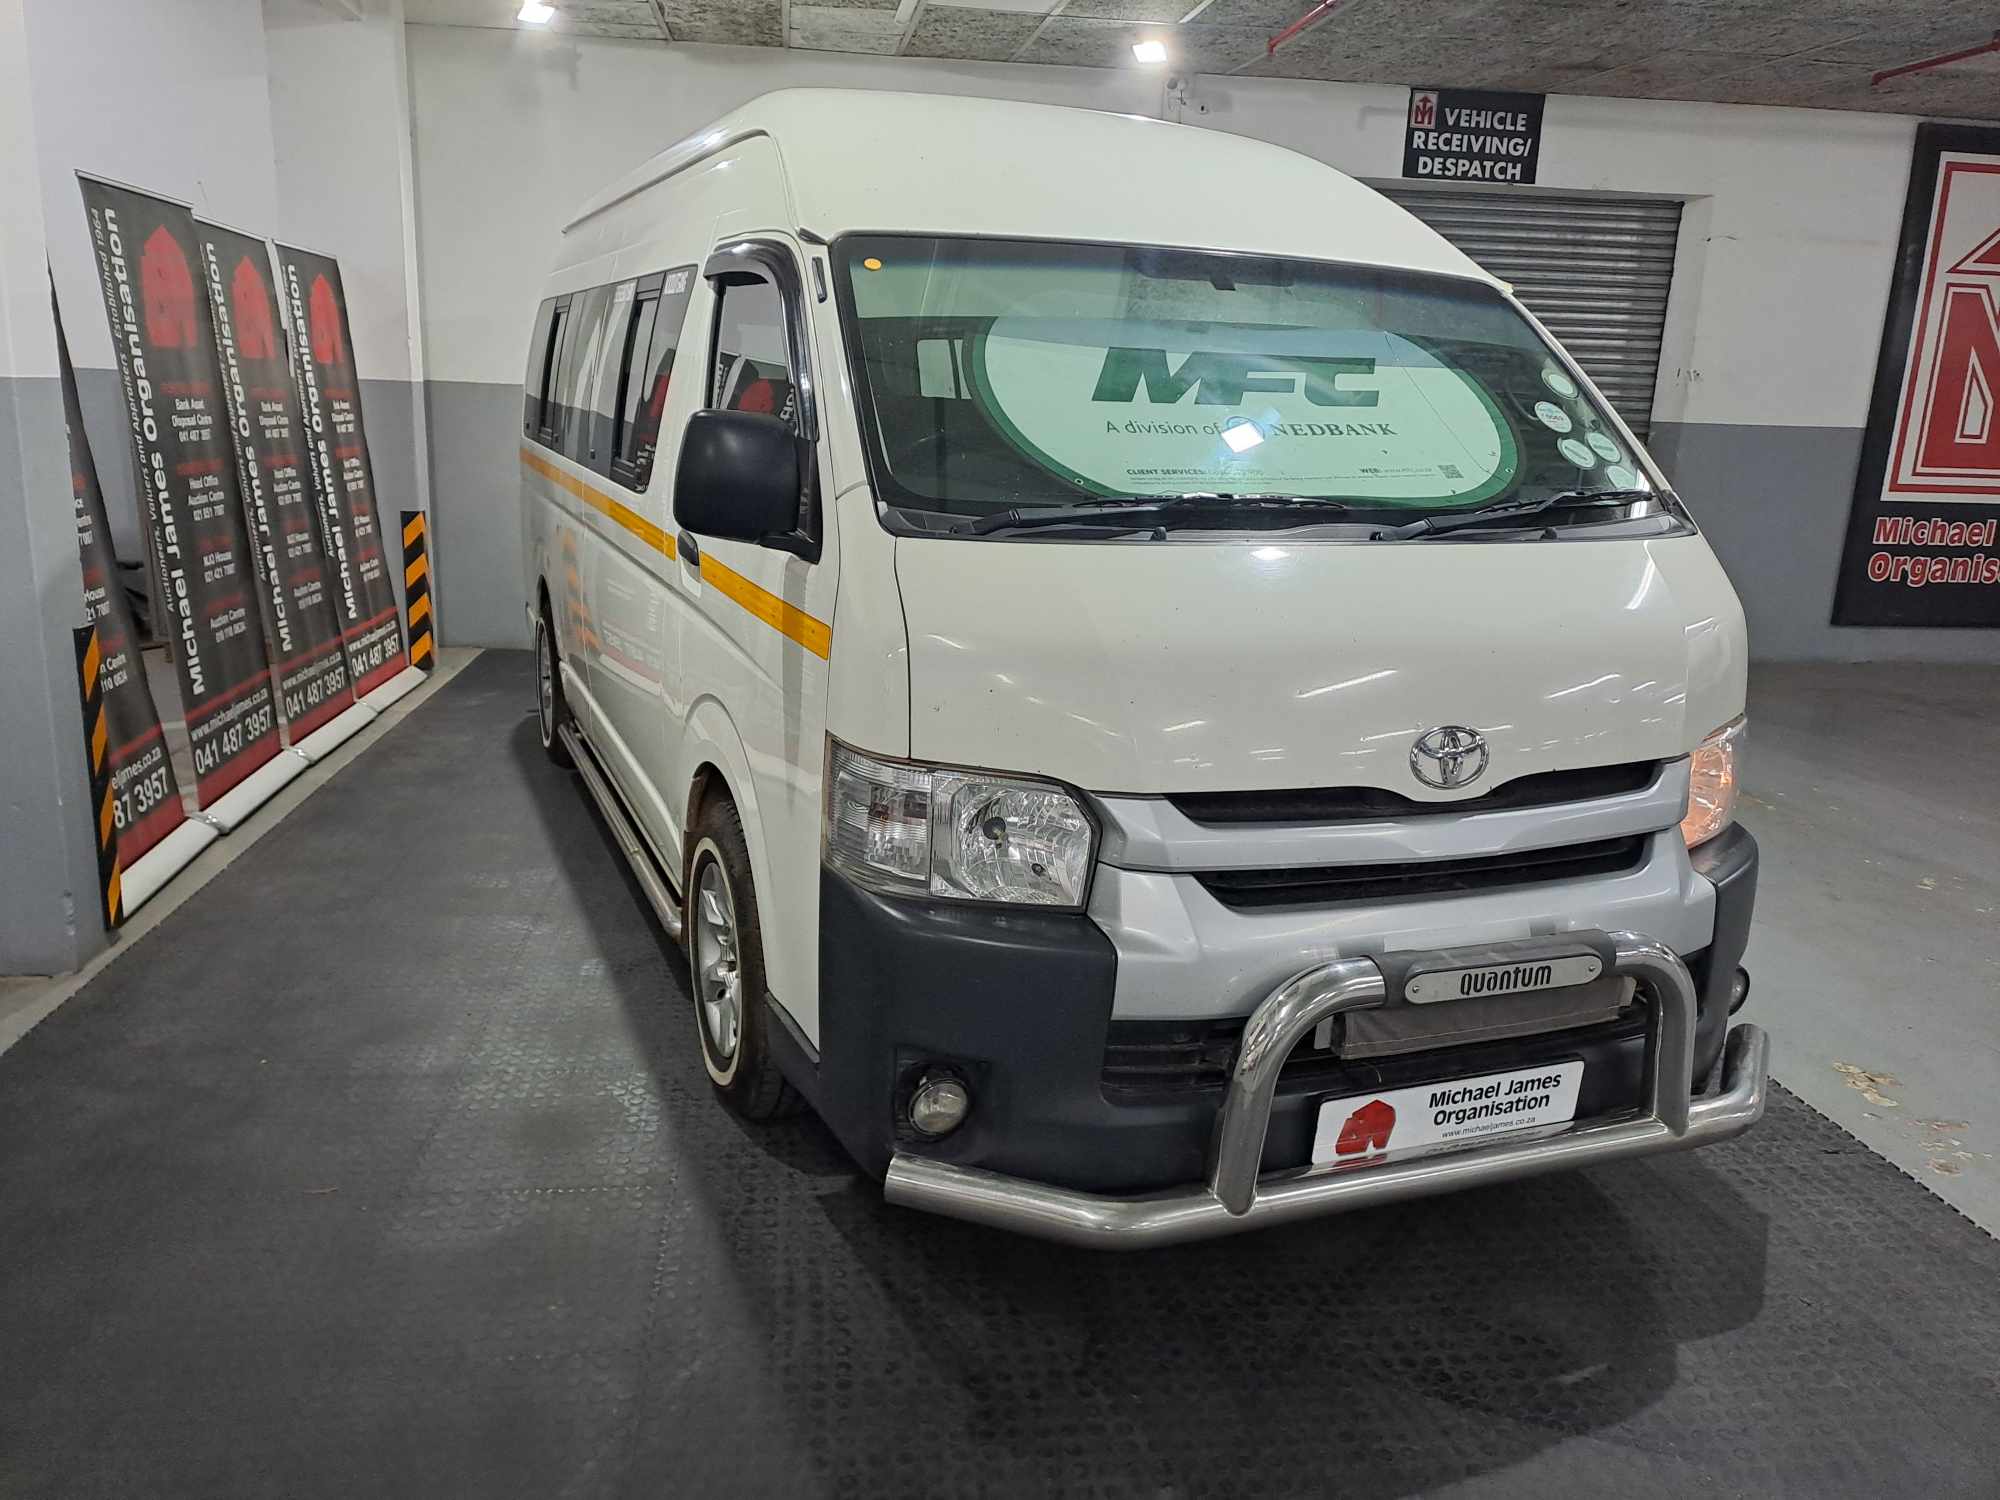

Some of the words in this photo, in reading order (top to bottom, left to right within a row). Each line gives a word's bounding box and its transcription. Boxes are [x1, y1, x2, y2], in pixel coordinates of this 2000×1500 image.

[1412, 130, 1532, 157] RECEIVING/
[1444, 107, 1528, 132] VEHICLE
[1417, 156, 1522, 180] DESPATCH
[90, 207, 105, 246] 1964
[100, 251, 123, 339] Established
[103, 208, 158, 442] Organisation
[205, 241, 250, 438] Organisation
[286, 264, 323, 432] Organisation
[119, 352, 142, 432] Appraisers
[1091, 346, 1380, 407] MFC
[134, 434, 147, 464] and
[304, 427, 314, 450] and
[1105, 420, 1120, 433] A
[1124, 419, 1198, 435] division
[1203, 420, 1221, 435] of
[1270, 422, 1400, 437] NEDBANK
[138, 467, 157, 521] Valuers
[245, 446, 271, 537] James
[308, 451, 322, 491] Valuers
[317, 439, 340, 520] James
[1126, 468, 1158, 476] CLIENT
[150, 451, 181, 559] James
[1872, 516, 1997, 547] Michael
[331, 525, 357, 619] Michael
[1868, 551, 2000, 588] Organis
[262, 544, 293, 652] Michael
[170, 568, 205, 695] Michael
[352, 652, 369, 677] 041
[369, 643, 383, 667] 487
[383, 633, 400, 658] 3957
[286, 690, 306, 719] 041
[306, 678, 324, 705] 487
[323, 665, 345, 696] 3957
[195, 738, 220, 775] 041
[222, 723, 243, 756] 487
[244, 704, 271, 741] 3957
[113, 793, 132, 829] 87
[134, 766, 169, 813] 3957
[1429, 1081, 1501, 1109] Michael
[1504, 1074, 1562, 1096] James
[1433, 1094, 1551, 1126] Organisation
[1442, 1117, 1536, 1138] www.michaeljames.co.za
